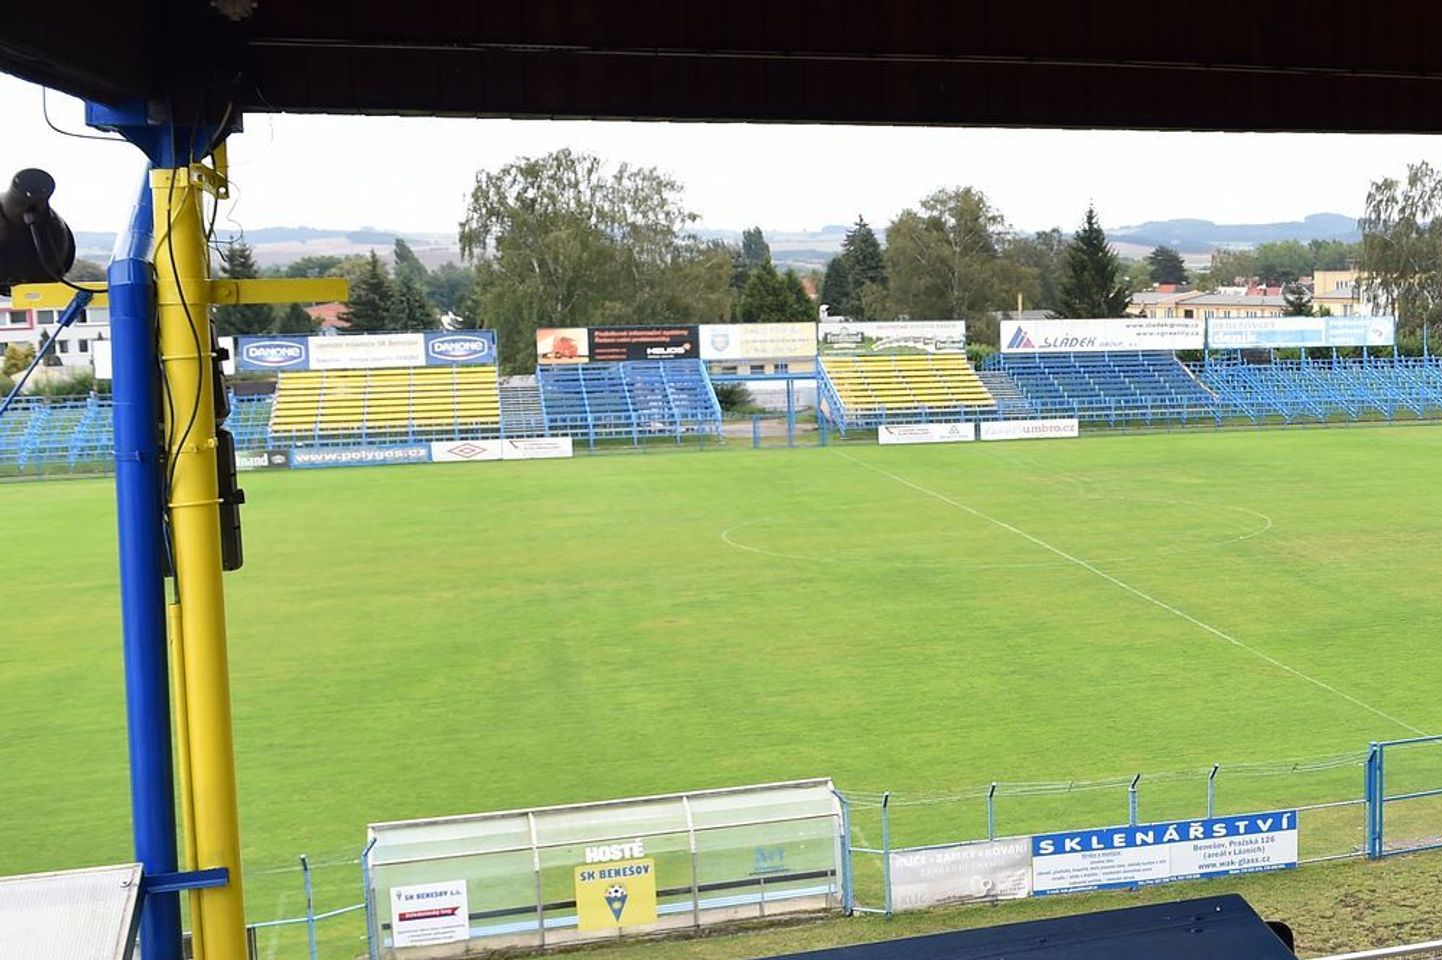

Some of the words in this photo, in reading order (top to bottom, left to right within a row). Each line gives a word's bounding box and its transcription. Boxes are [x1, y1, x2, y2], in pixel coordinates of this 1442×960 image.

[434, 341, 483, 352] DANONE
[1039, 333, 1097, 348] SLÁDEK
[248, 346, 300, 357] DANONE
[1022, 423, 1075, 434] umbro.cz
[295, 449, 426, 464] www.polygas.cz
[1038, 812, 1291, 854] SKLENÁŘSTVÍ
[584, 838, 645, 864] HOSTÉ
[1193, 841, 1228, 852] Benešov,
[1229, 836, 1259, 848] Pražská
[579, 869, 596, 881] SK
[599, 864, 651, 880] BENEŠOV
